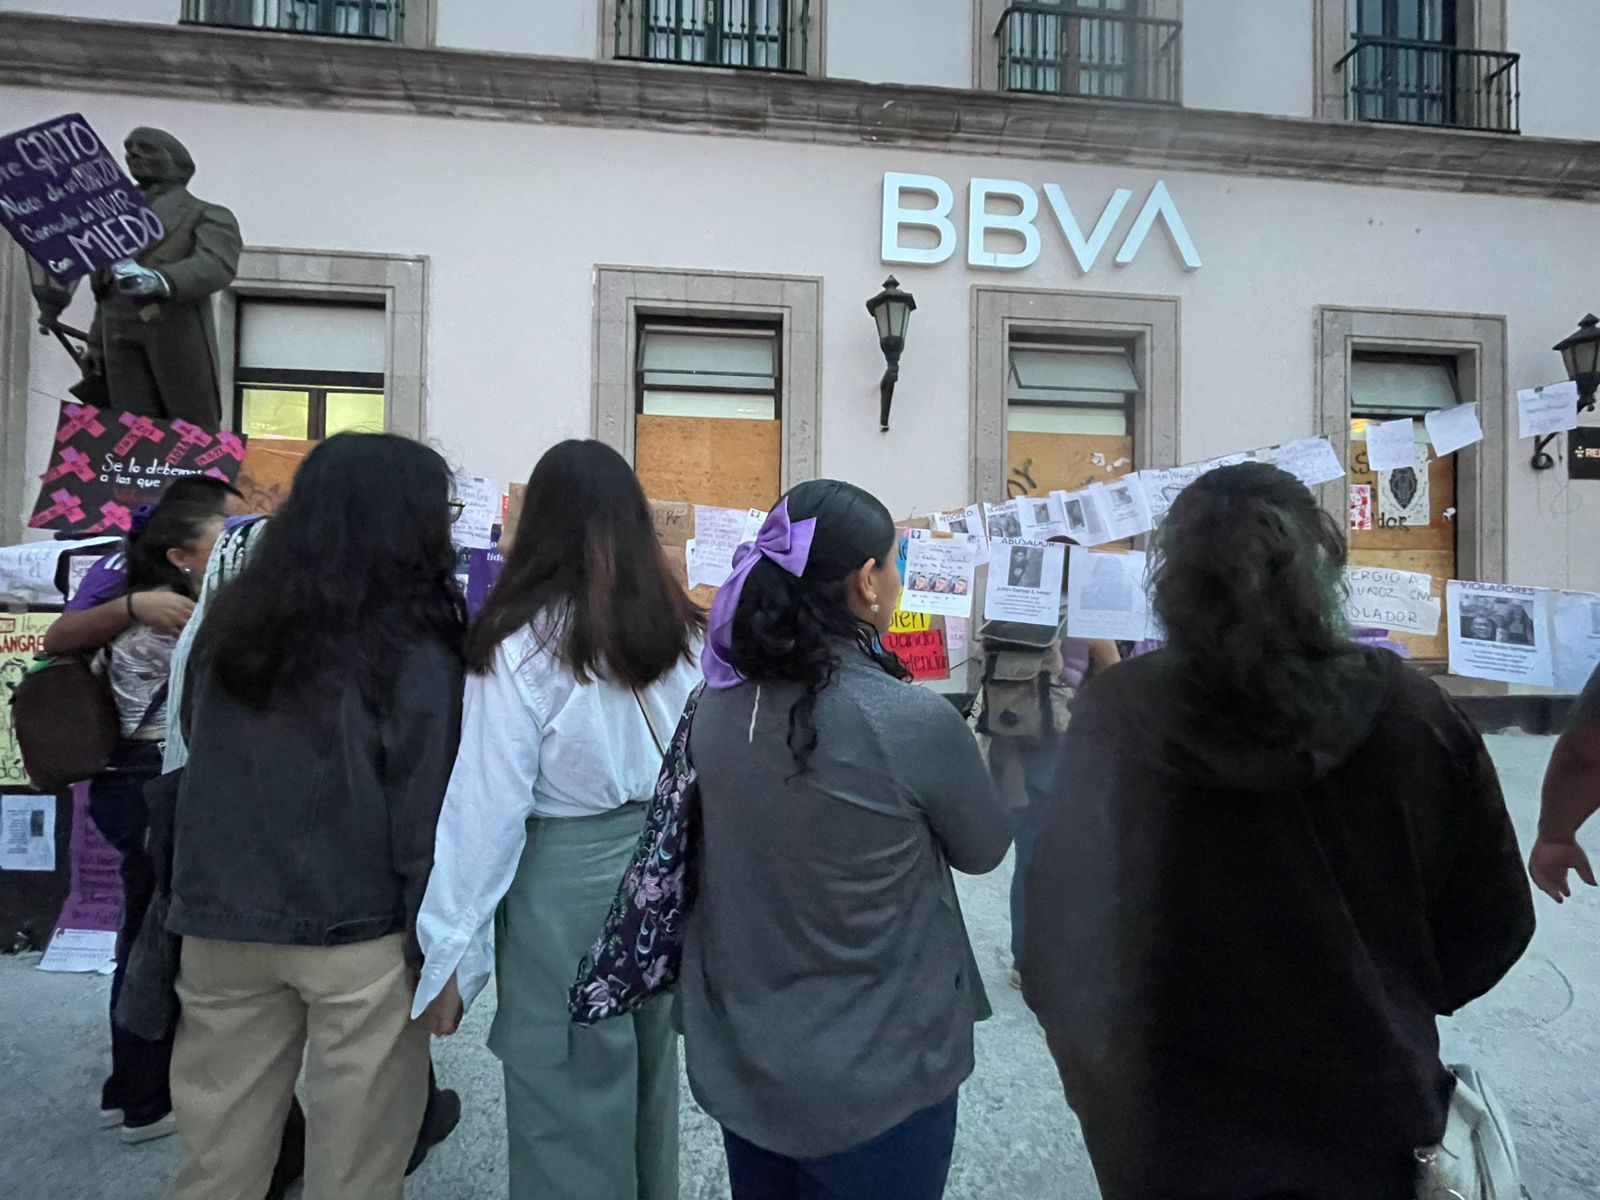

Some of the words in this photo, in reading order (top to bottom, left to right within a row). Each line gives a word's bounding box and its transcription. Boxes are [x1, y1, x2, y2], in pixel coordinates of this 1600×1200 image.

[15, 121, 99, 177] GRITO
[881, 171, 1203, 273] BBVA
[67, 207, 164, 271] MIEDO
[102, 453, 123, 472] Se
[128, 457, 141, 473] lo
[137, 478, 161, 488] que
[1350, 570, 1400, 583] ERGIO
[1460, 582, 1535, 596] VIOLADORES
[890, 611, 925, 629] ien
[1350, 606, 1417, 623] OLADOR
[0, 634, 45, 653] ANGRE
[888, 630, 935, 648] uando
